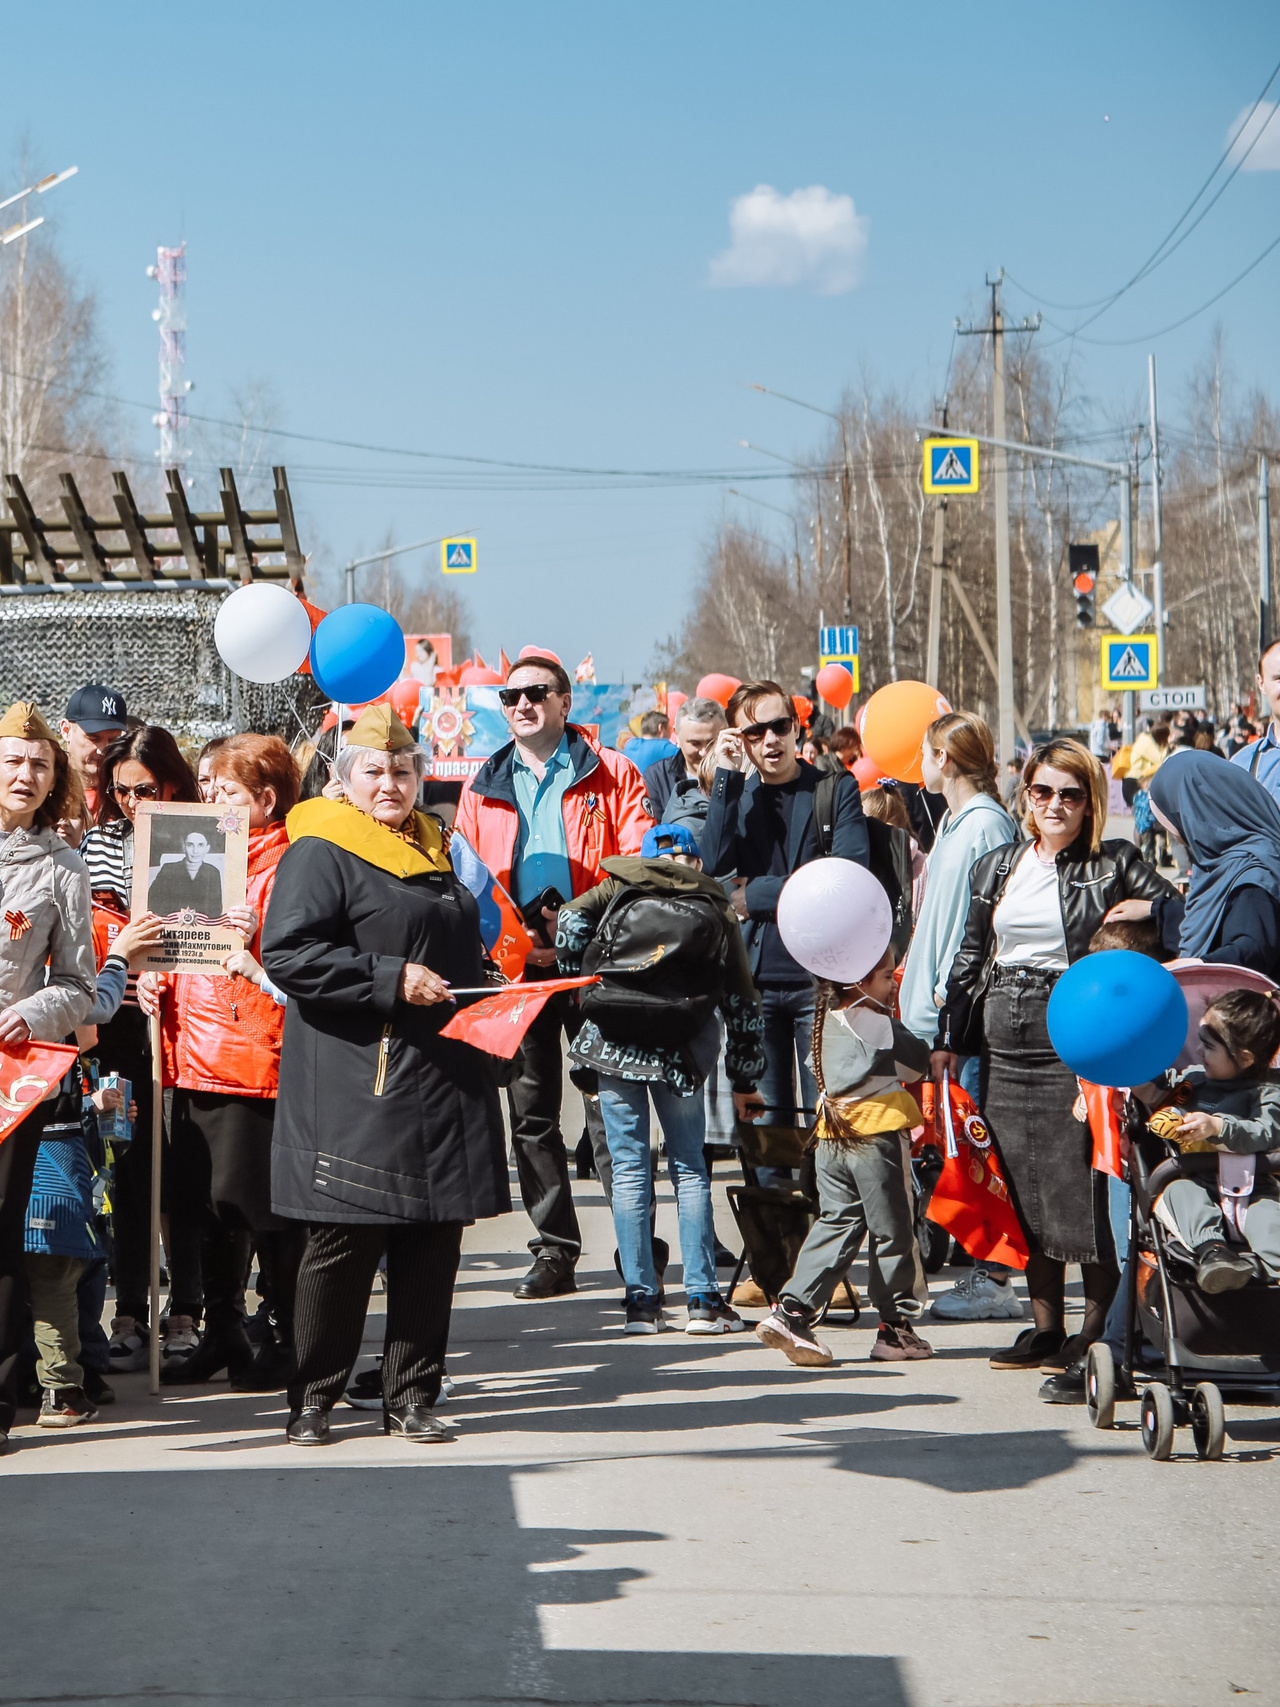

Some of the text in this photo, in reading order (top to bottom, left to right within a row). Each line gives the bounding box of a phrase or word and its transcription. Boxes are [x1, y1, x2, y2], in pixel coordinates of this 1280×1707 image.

[101, 696, 117, 715] NY
[1149, 691, 1196, 706] СТОП
[180, 941, 232, 951] Махмутович
